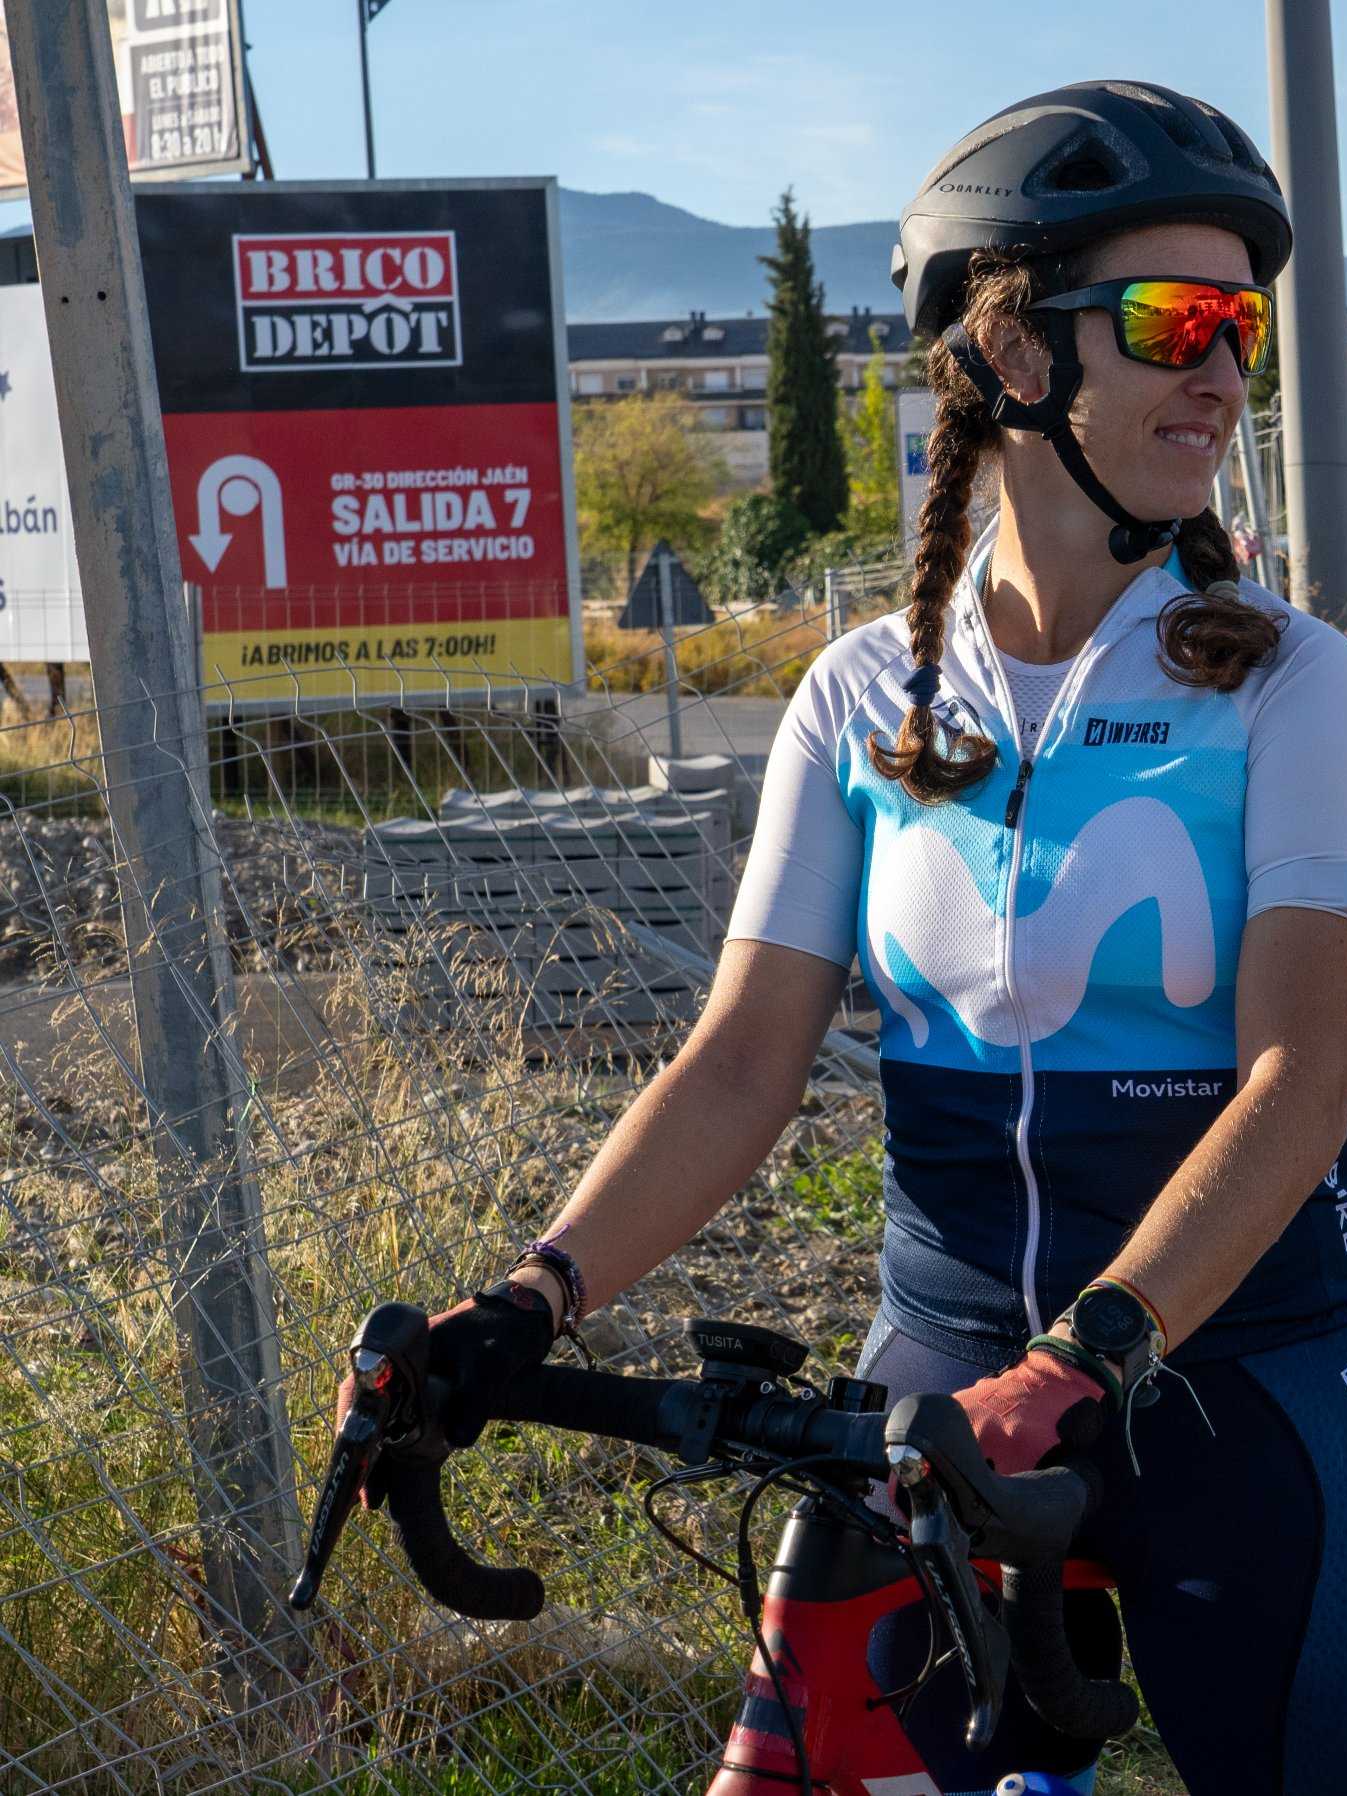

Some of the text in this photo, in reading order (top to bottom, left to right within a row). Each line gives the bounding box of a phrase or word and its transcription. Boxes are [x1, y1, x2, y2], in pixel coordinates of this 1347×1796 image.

[956, 184, 1013, 198] OAKLEY
[247, 247, 445, 293] BRICO
[331, 463, 529, 491] GR-30 DIRECCIÓN JAÉN
[0, 494, 58, 534] bán
[331, 487, 532, 535] SALIDA 7
[333, 535, 535, 568] VÍA DE SERVICIO
[241, 641, 350, 666] ¡ABRIMOS
[355, 640, 371, 662] A
[376, 637, 420, 660] LAS
[1110, 1076, 1223, 1099] Movistar
[698, 1334, 744, 1351] TUSITA
